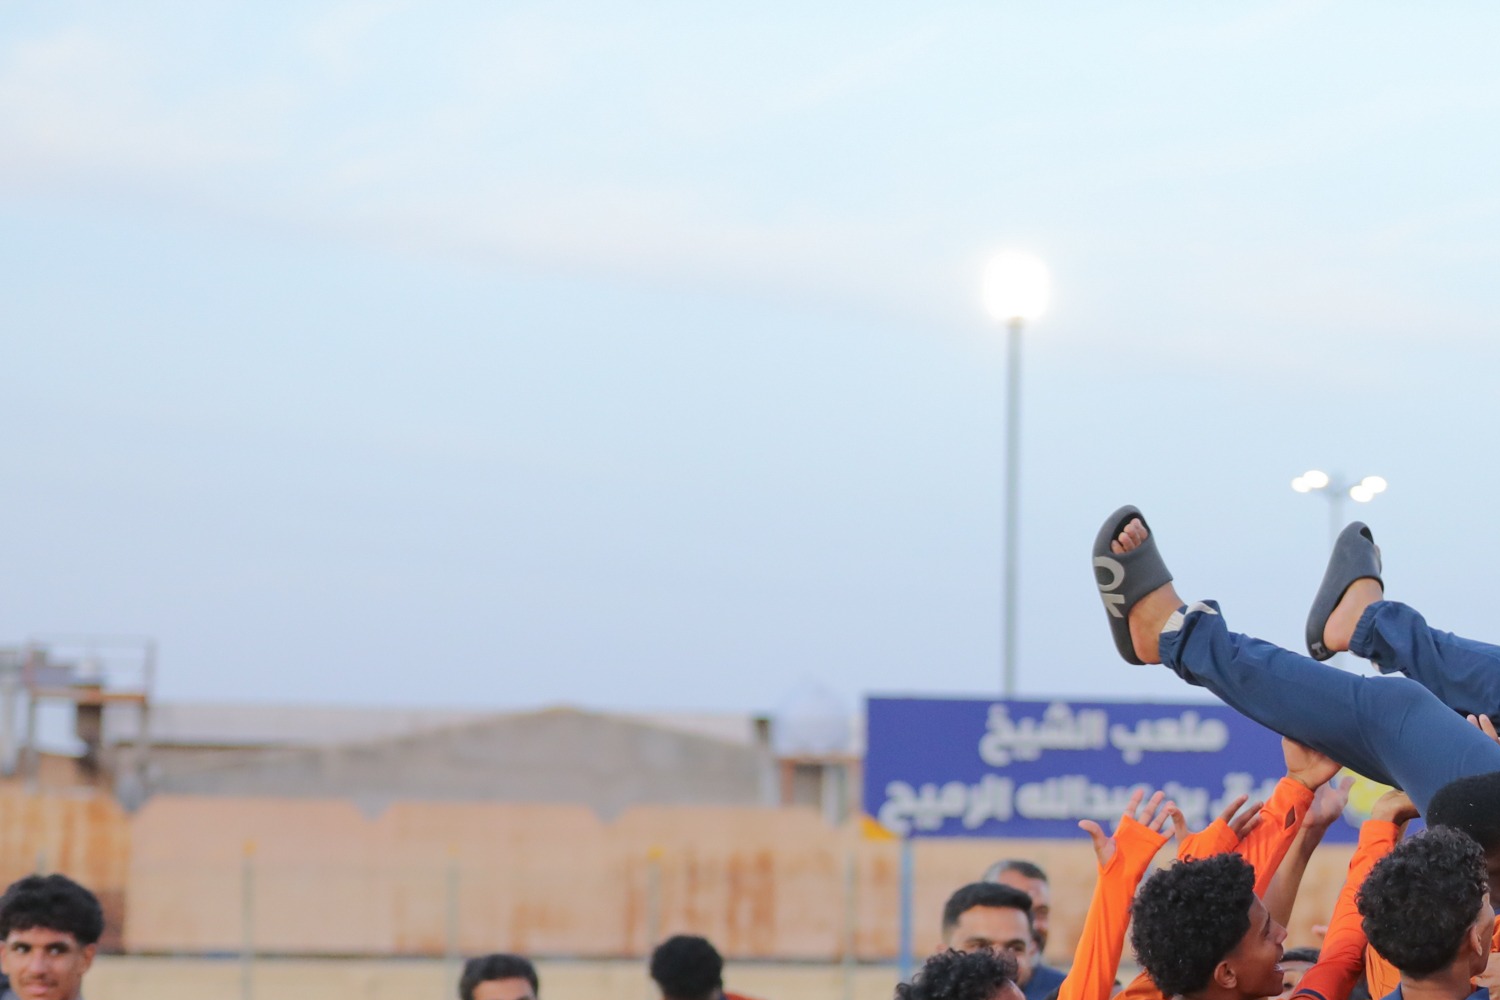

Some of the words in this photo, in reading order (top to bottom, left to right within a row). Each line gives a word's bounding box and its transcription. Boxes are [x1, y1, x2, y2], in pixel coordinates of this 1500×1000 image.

[979, 701, 1107, 767] الشيخ
[1110, 710, 1229, 765] ملعب
[878, 773, 1014, 837] الرميح
